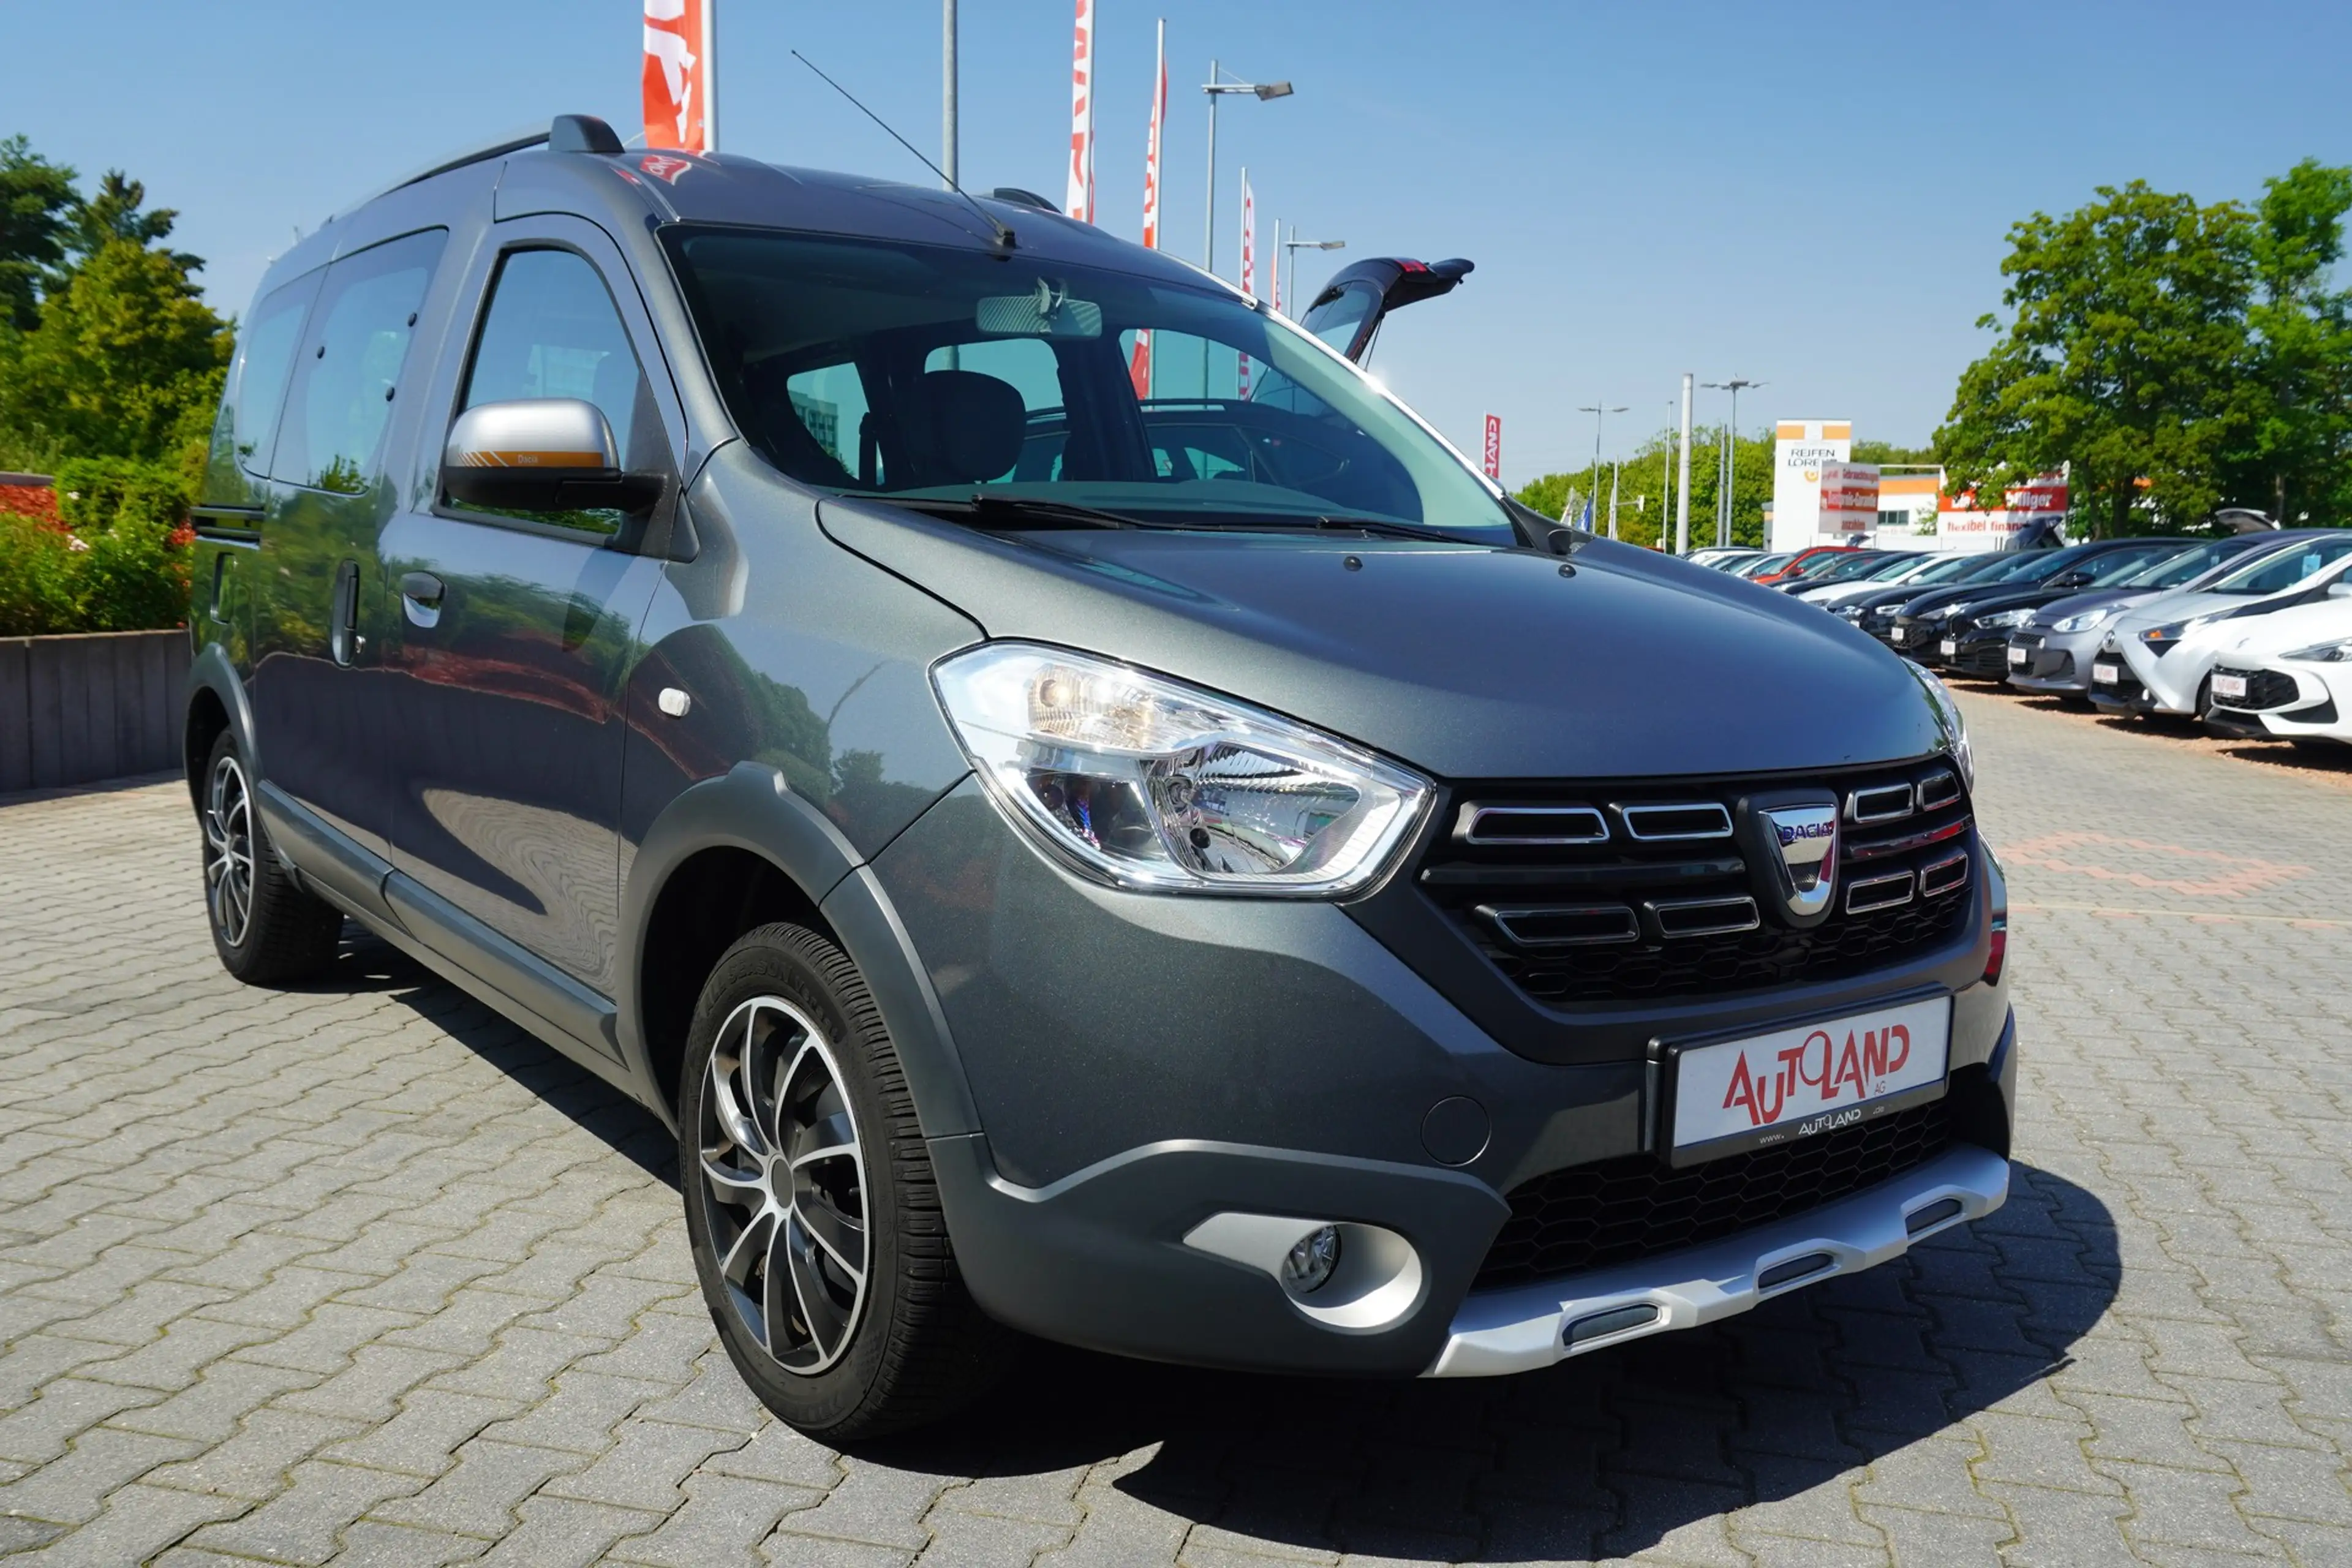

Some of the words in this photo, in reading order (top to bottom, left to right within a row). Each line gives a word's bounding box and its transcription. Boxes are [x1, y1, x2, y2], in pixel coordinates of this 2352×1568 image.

[1790, 448, 1835, 458] REIFEN
[1948, 520, 1986, 531] flexibel
[1783, 822, 1833, 840] DACIA
[1874, 1080, 1887, 1096] AG
[1759, 1133, 1785, 1145] www.
[1872, 1104, 1885, 1115] .de
